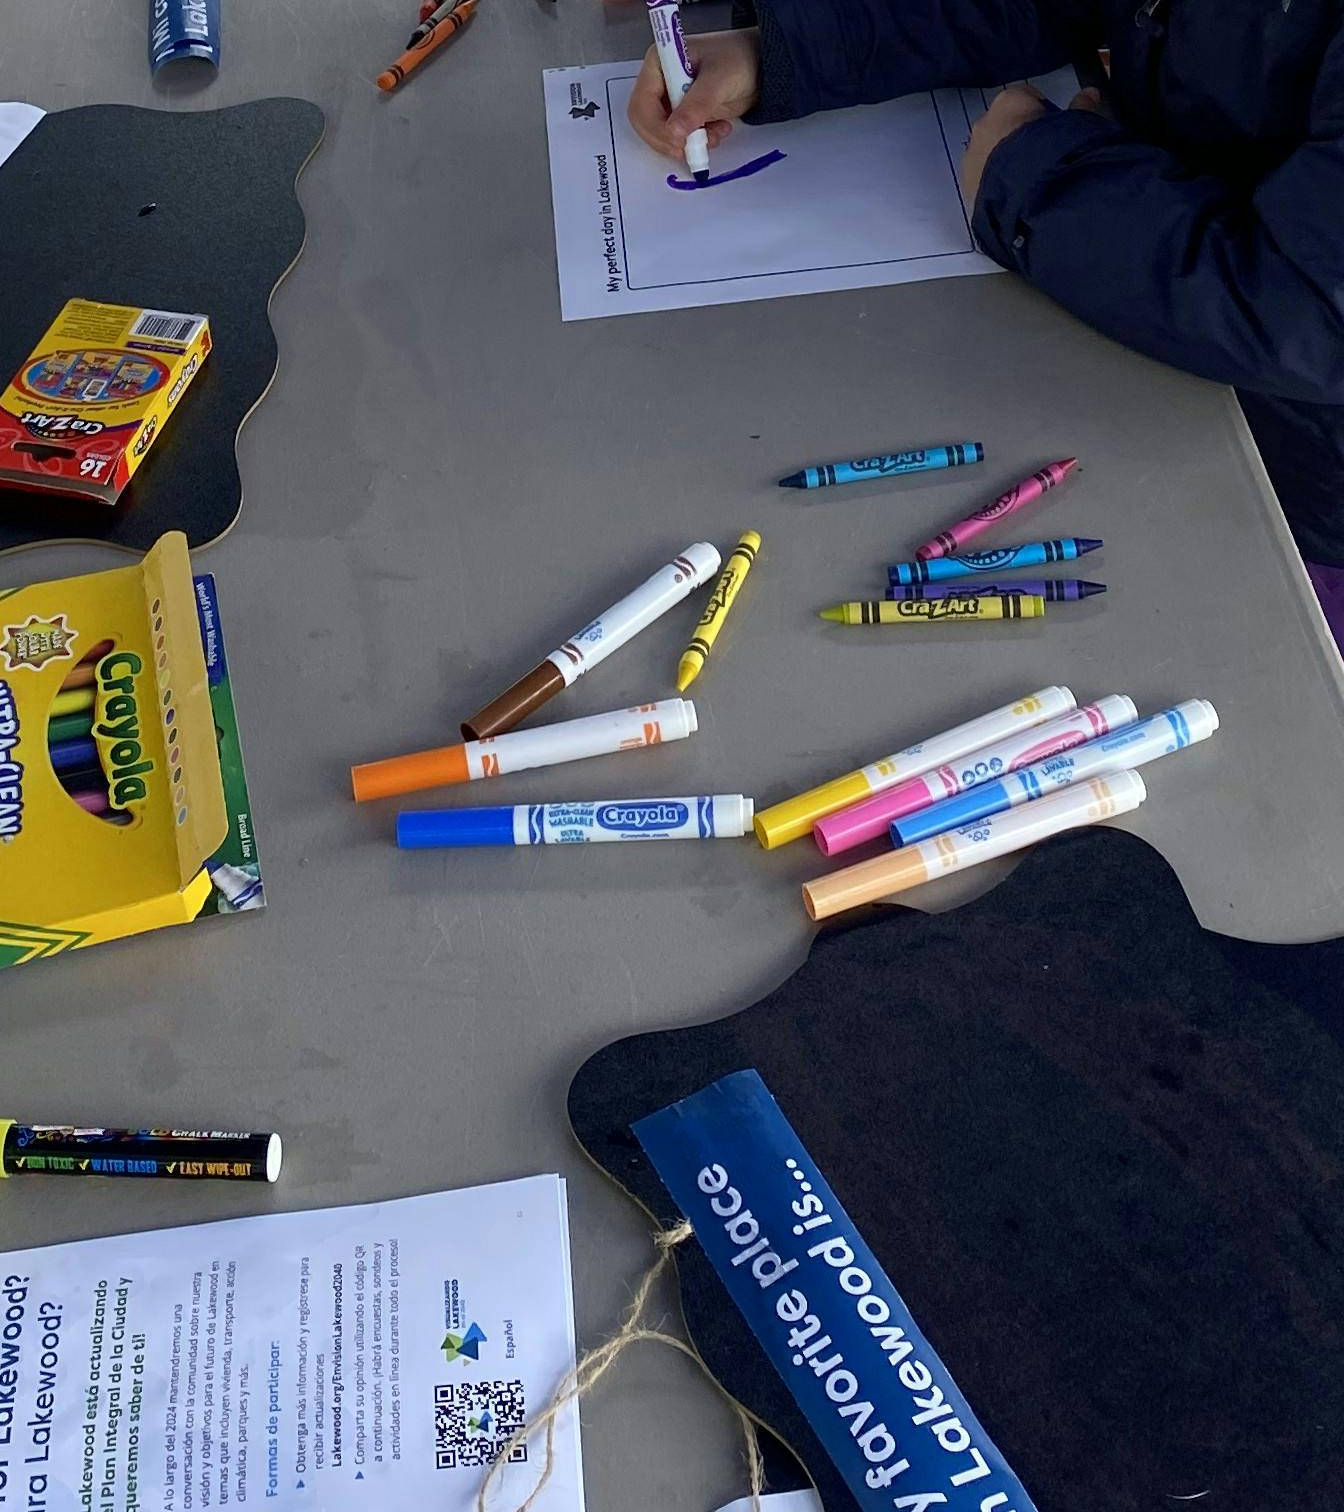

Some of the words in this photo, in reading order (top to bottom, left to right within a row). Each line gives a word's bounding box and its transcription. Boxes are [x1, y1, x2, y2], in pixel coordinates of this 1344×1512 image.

[594, 154, 611, 204] Lakewood
[599, 204, 611, 215] in
[601, 217, 616, 234] day
[603, 239, 621, 275] perfect
[607, 278, 622, 293] My
[80, 457, 108, 478] 16
[196, 582, 209, 610] World's
[96, 653, 154, 805] Crayola
[237, 814, 248, 838] Broad
[549, 809, 594, 817] ULTRA-CLEAN
[549, 817, 593, 827] WASHABLE
[605, 805, 677, 827] Crayola
[241, 840, 250, 858] Line
[48, 1157, 74, 1169] TOXIC
[91, 1159, 125, 1172] WATER
[127, 1160, 157, 1173] BASED
[180, 1161, 204, 1175] EASY
[206, 1162, 251, 1176] WIPE-OUT
[785, 1157, 833, 1236] is...
[697, 1162, 800, 1289] place
[119, 1276, 133, 1286] y
[112, 1289, 128, 1341] Ciudad
[174, 1303, 183, 1319] una
[451, 1279, 460, 1329] LAKEWOOD
[90, 1279, 108, 1380] actualizando
[132, 1333, 146, 1350] ti!
[503, 1319, 516, 1359] Español
[110, 1344, 124, 1359] la
[130, 1354, 144, 1376] de
[169, 1320, 182, 1404] mantendremos
[331, 1263, 344, 1468] Lakewood.org/EnvisionLakewood2040
[808, 1236, 991, 1487] Lakewood
[108, 1362, 122, 1383] de
[268, 1340, 283, 1412] participar:
[295, 1337, 307, 1398] información
[24, 1301, 64, 1463] Lakewood?
[776, 1288, 911, 1491] favorite
[85, 1389, 99, 1420] está
[128, 1378, 143, 1422] saber
[297, 1400, 307, 1421] más
[104, 1387, 123, 1454] Integral
[166, 1406, 176, 1431] 2024
[266, 1415, 278, 1434] de
[166, 1434, 176, 1453] del
[295, 1423, 308, 1473] Obtenga
[101, 1457, 116, 1498] Plan
[126, 1425, 140, 1512] queremos
[164, 1456, 178, 1486] largo
[266, 1438, 278, 1498] Formas
[164, 1487, 174, 1501] lo
[164, 1502, 173, 1511] A
